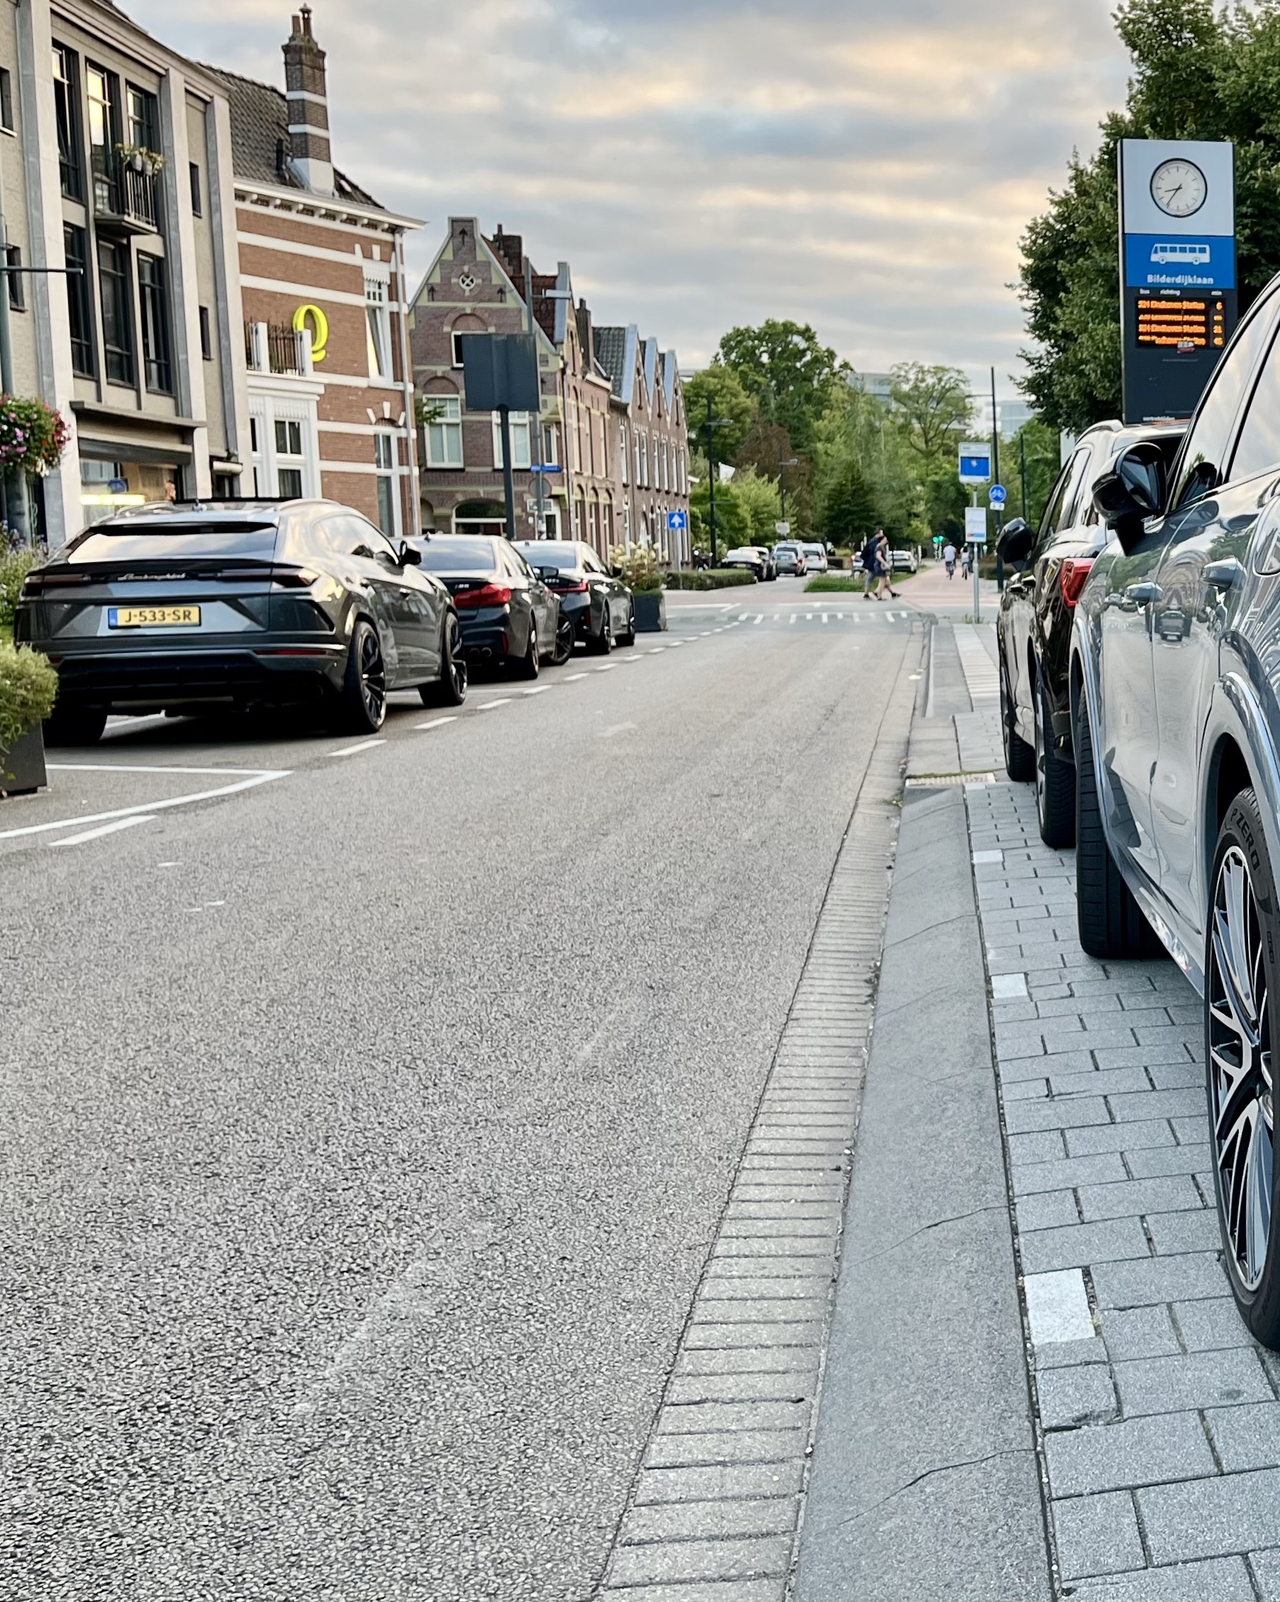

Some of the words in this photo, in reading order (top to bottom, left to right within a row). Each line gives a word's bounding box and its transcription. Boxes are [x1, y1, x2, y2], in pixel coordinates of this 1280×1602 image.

[1147, 274, 1214, 286] Bilderdijklaan
[125, 609, 192, 623] J-533-SR
[1236, 812, 1260, 871] ZERO
